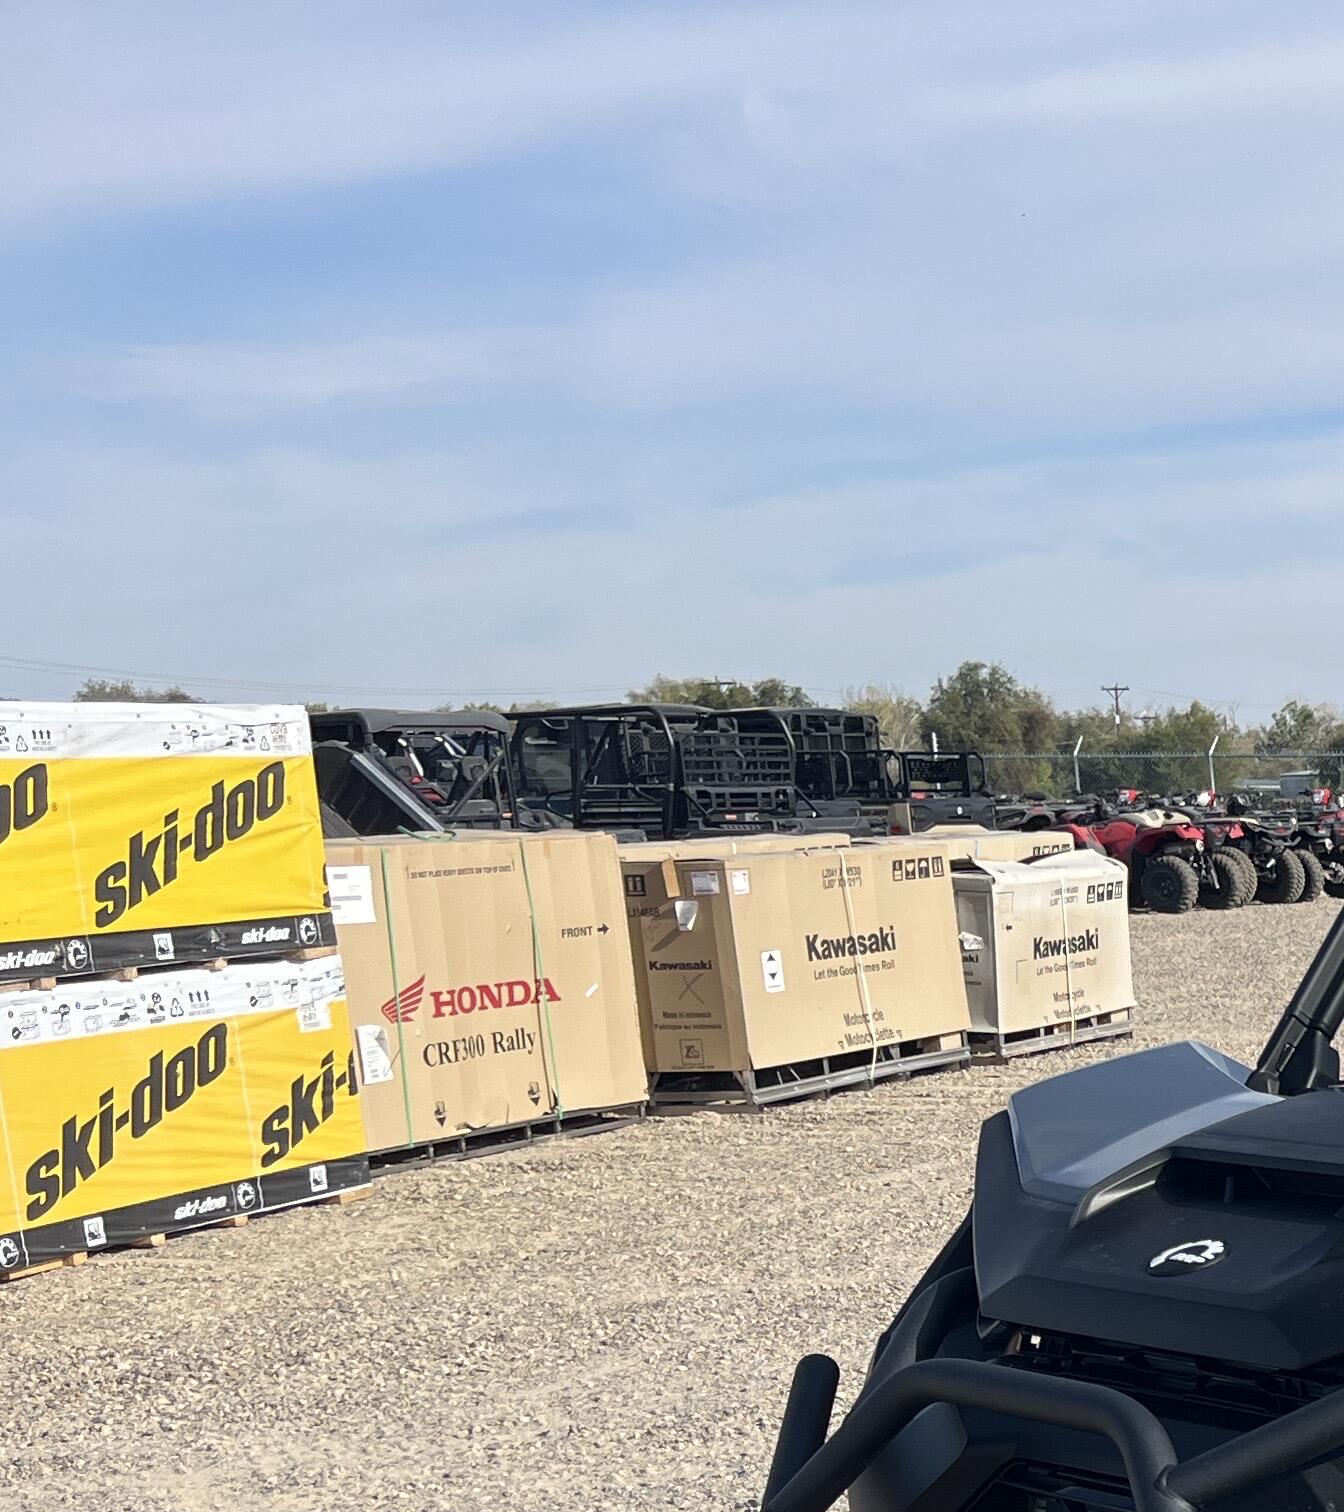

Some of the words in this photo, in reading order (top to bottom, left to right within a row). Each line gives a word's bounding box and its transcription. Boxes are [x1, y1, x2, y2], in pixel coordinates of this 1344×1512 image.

[95, 761, 284, 928] ski-doo
[241, 927, 290, 944] ski-doo
[561, 926, 592, 938] FRONT
[805, 925, 896, 961] Kawasaki
[1033, 928, 1099, 960] Kawasaki
[649, 960, 712, 971] Kawasaki
[430, 977, 561, 1018] HONDA
[423, 1034, 485, 1067] CRF300
[493, 1028, 537, 1056] Rally
[25, 1022, 228, 1222] ski-doo
